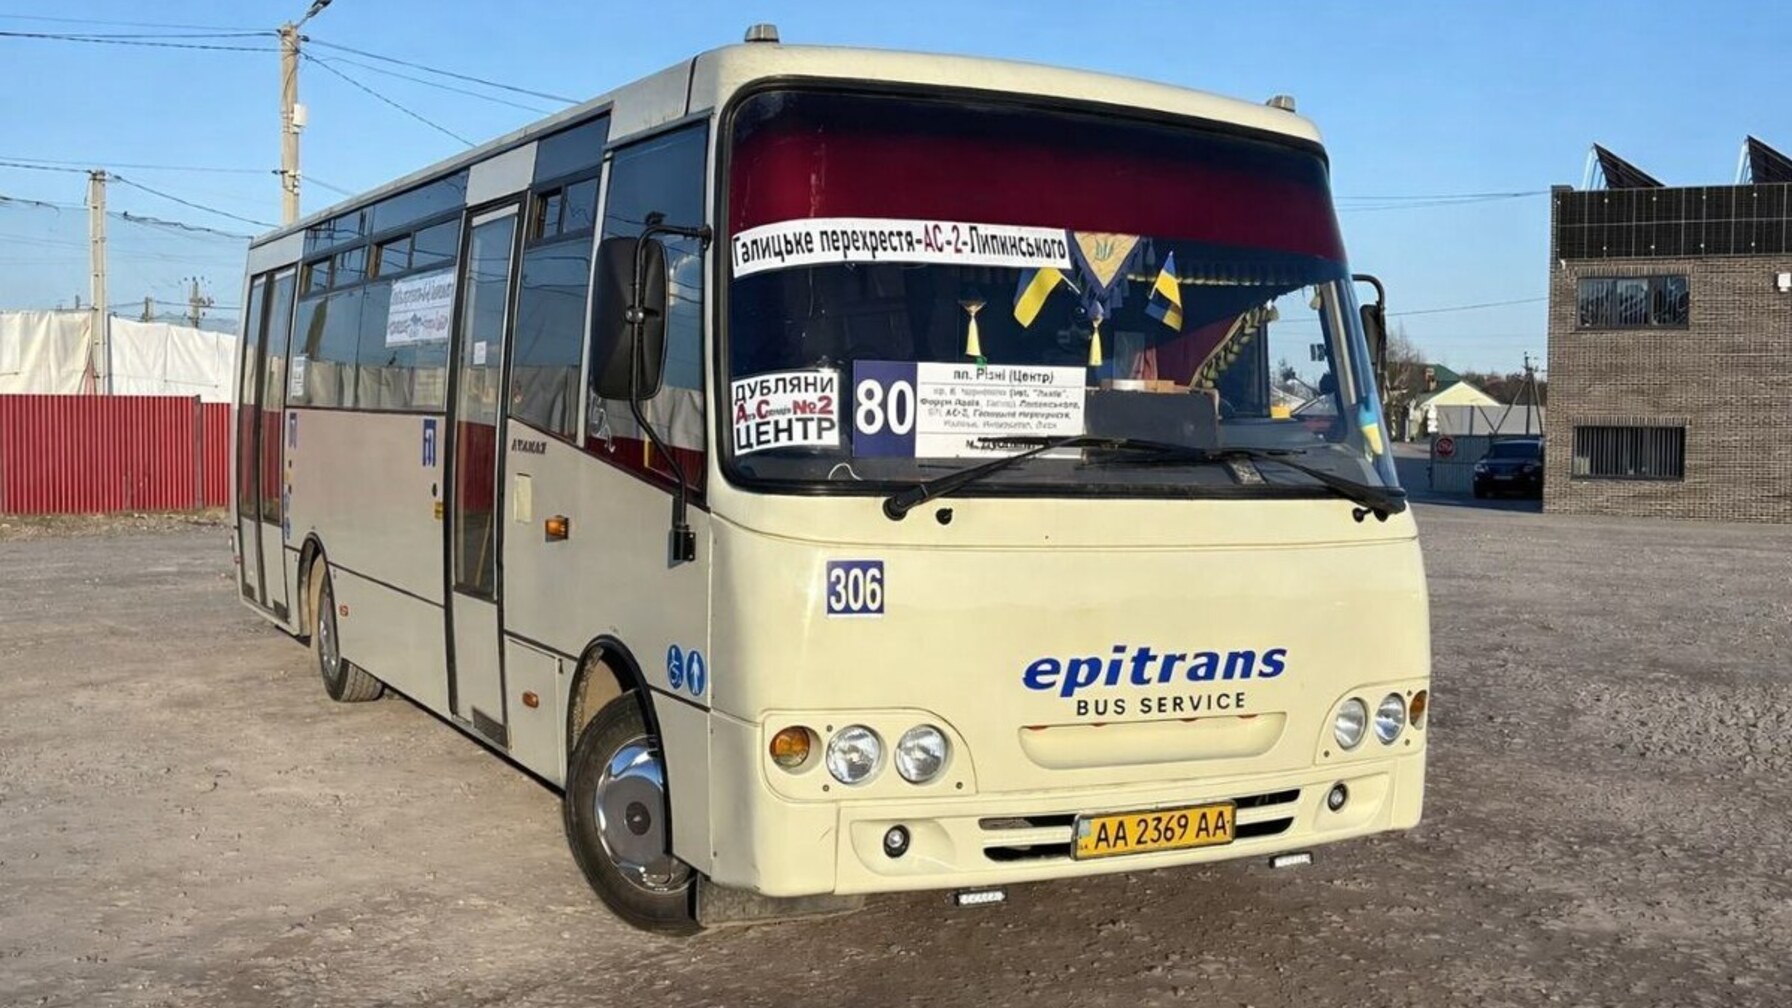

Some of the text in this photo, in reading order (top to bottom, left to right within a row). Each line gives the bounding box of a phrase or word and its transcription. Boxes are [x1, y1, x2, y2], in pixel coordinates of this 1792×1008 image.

[733, 229, 814, 267] Галицьке
[735, 376, 834, 406] ДУБЛЯНИ
[953, 370, 973, 381] пл.
[855, 379, 915, 435] 80
[736, 417, 836, 451] ЦЕНТР
[830, 567, 882, 612] 306
[1023, 645, 1288, 697] epitrans
[1076, 692, 1246, 716] BUS SERVICE
[1094, 810, 1228, 850] AA 2369 AA
